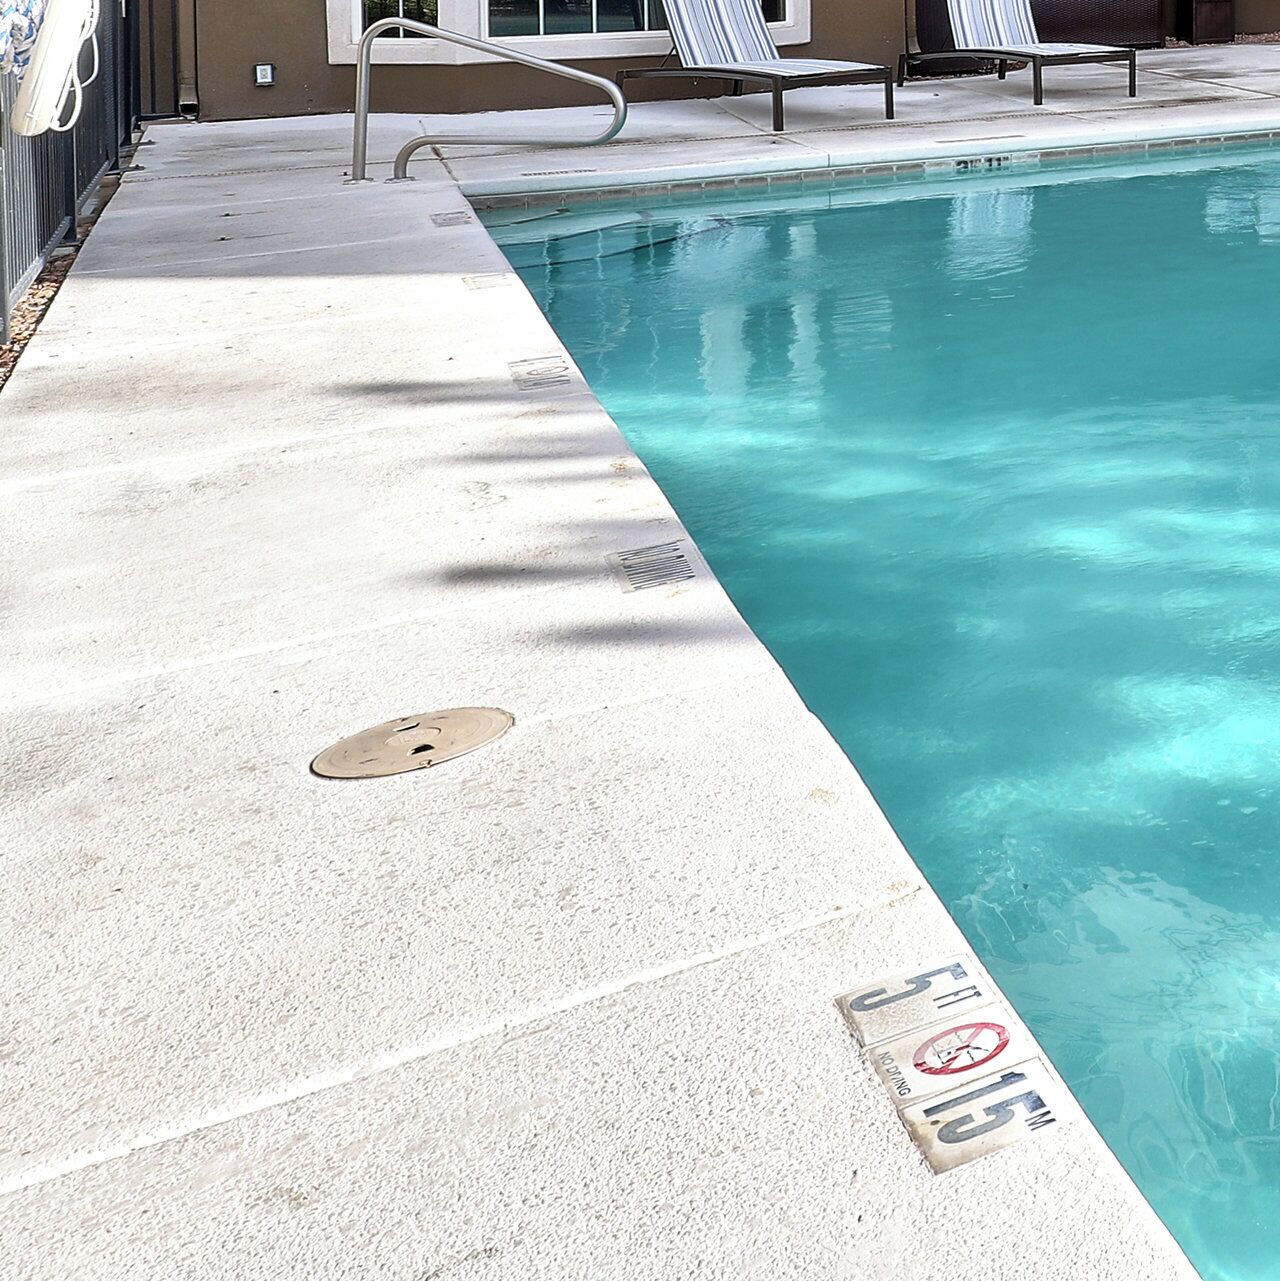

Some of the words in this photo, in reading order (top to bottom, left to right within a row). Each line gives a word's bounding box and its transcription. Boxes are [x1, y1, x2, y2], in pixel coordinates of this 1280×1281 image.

[850, 961, 968, 1012] 5
[932, 984, 982, 1009] FT
[877, 1051, 895, 1067] NO
[886, 1066, 911, 1097] DIVING
[1024, 1109, 1057, 1132] M
